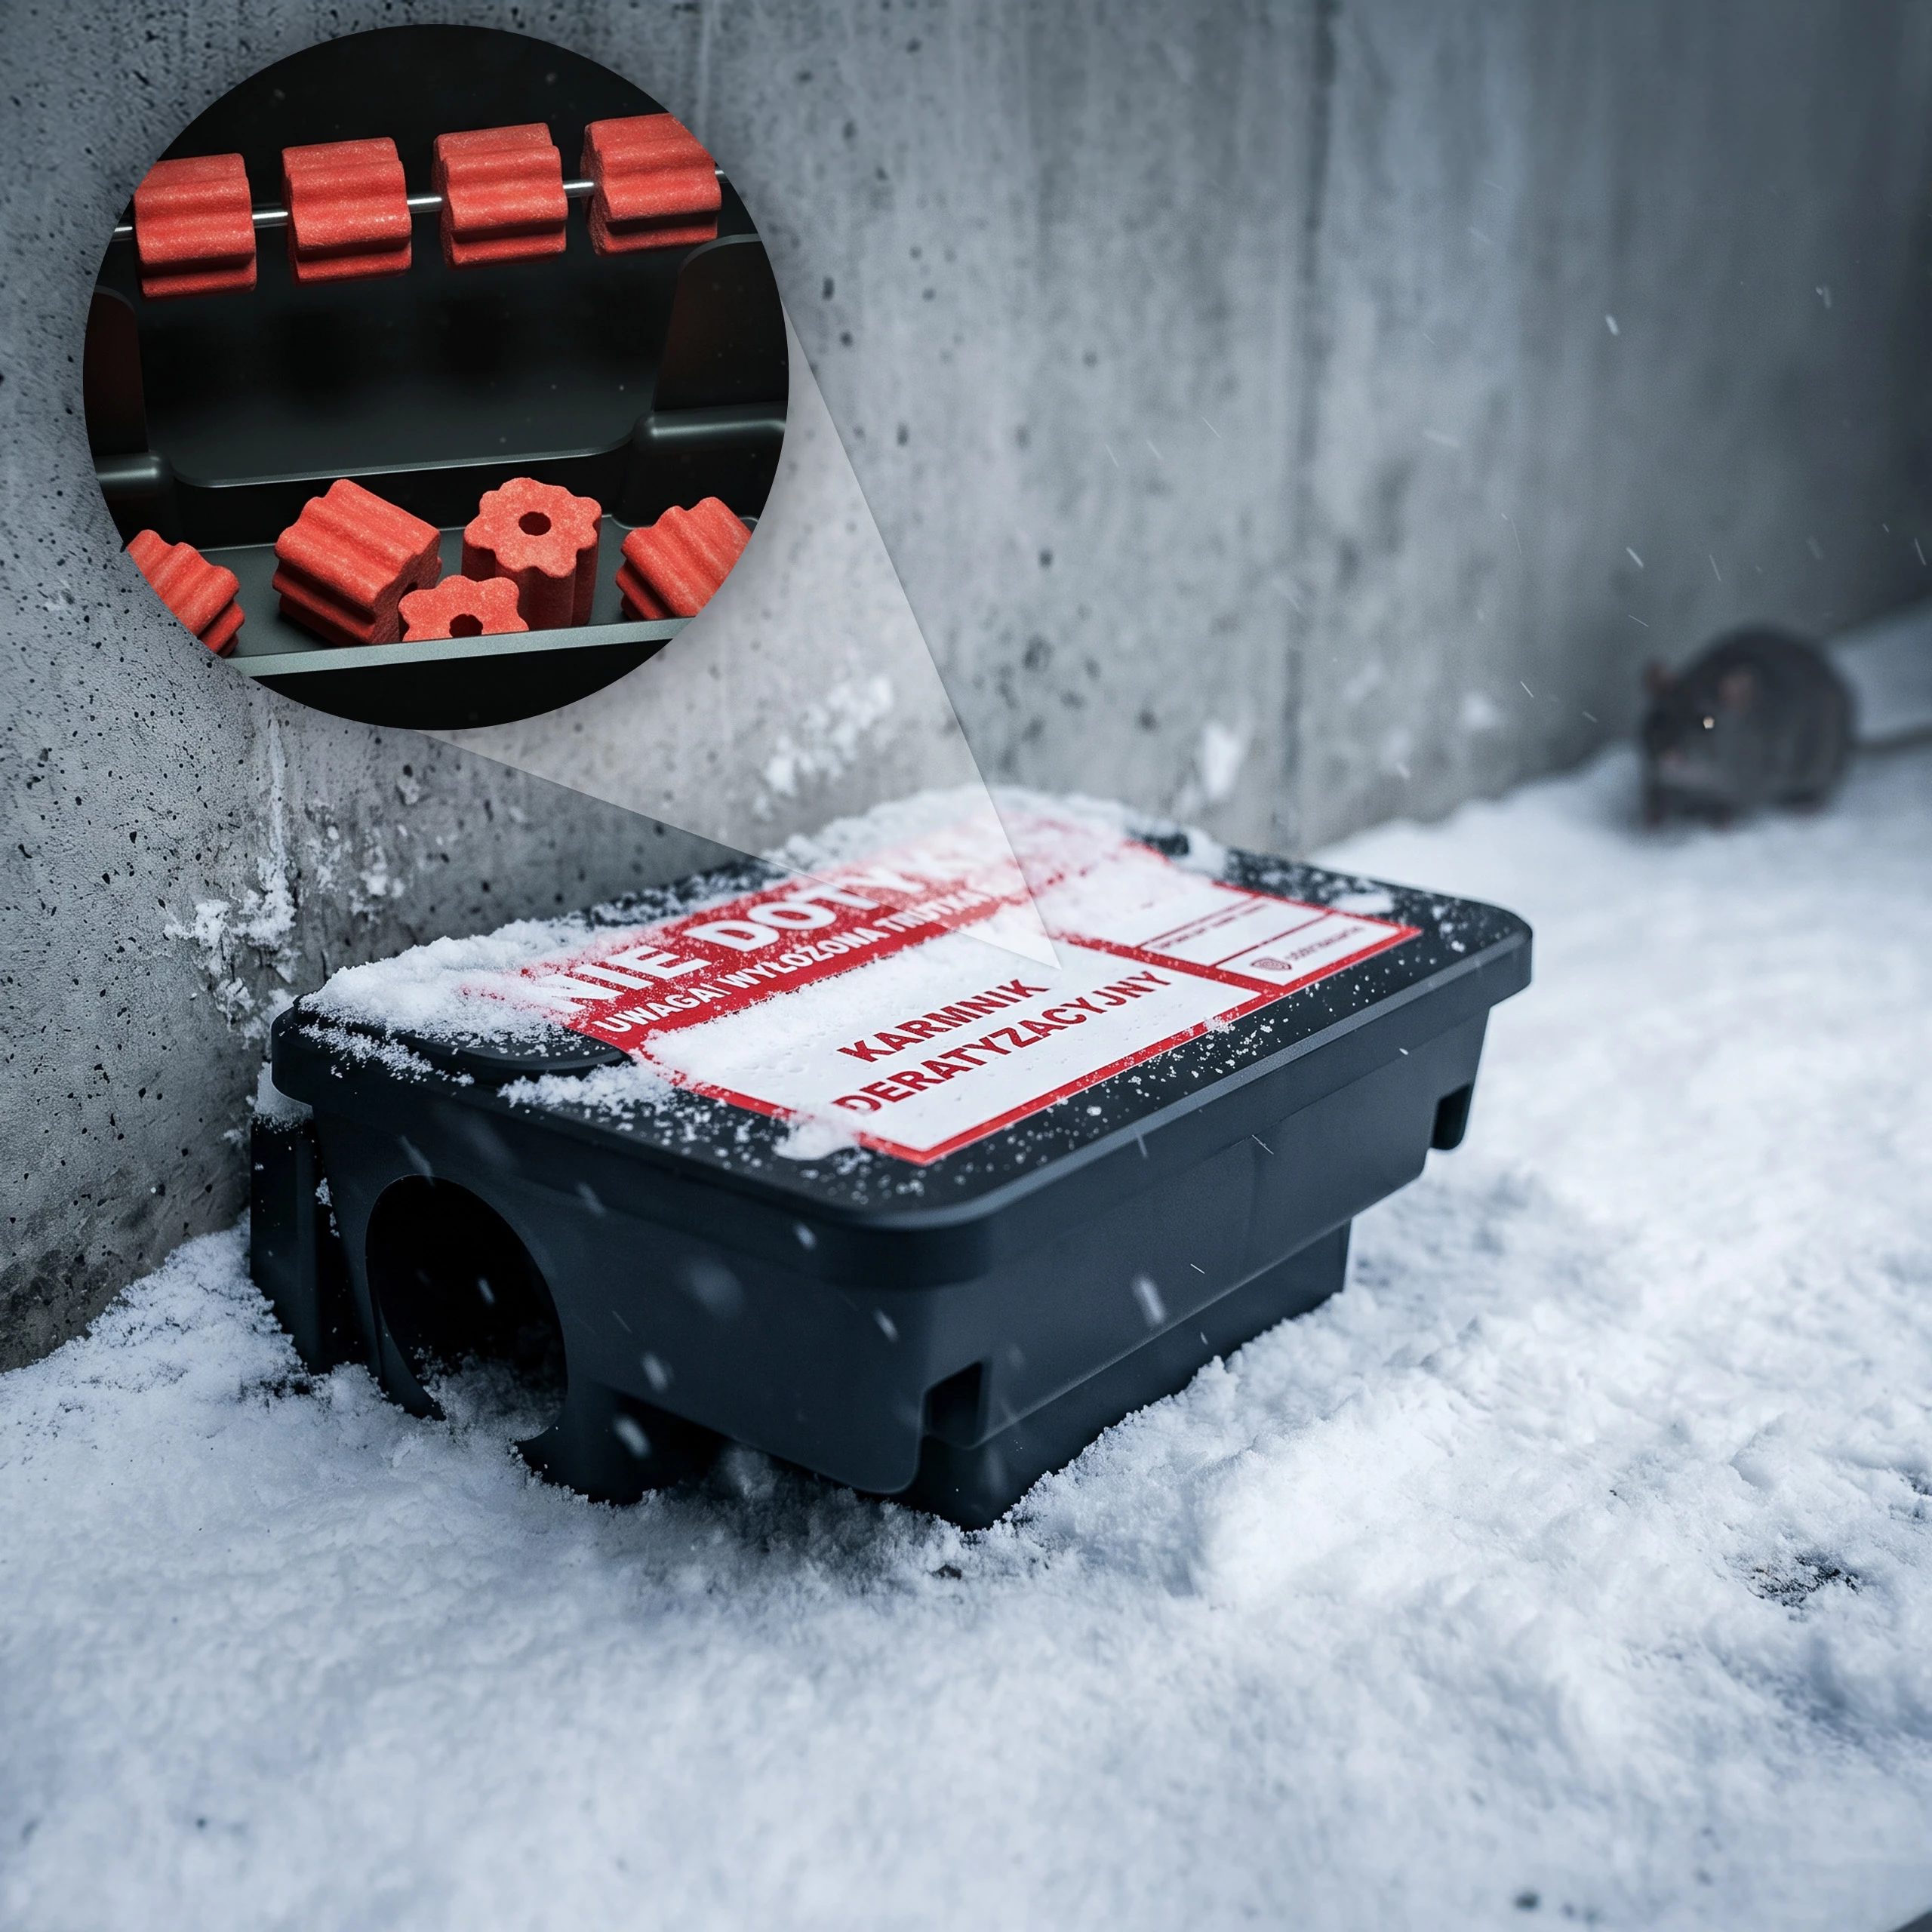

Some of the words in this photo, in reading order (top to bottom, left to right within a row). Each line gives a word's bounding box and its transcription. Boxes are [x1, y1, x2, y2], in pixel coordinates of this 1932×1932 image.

[525, 944, 712, 1013] NIE
[831, 971, 1172, 1113] DERATYZACYJNY
[836, 979, 1051, 1063] KARMNIK
